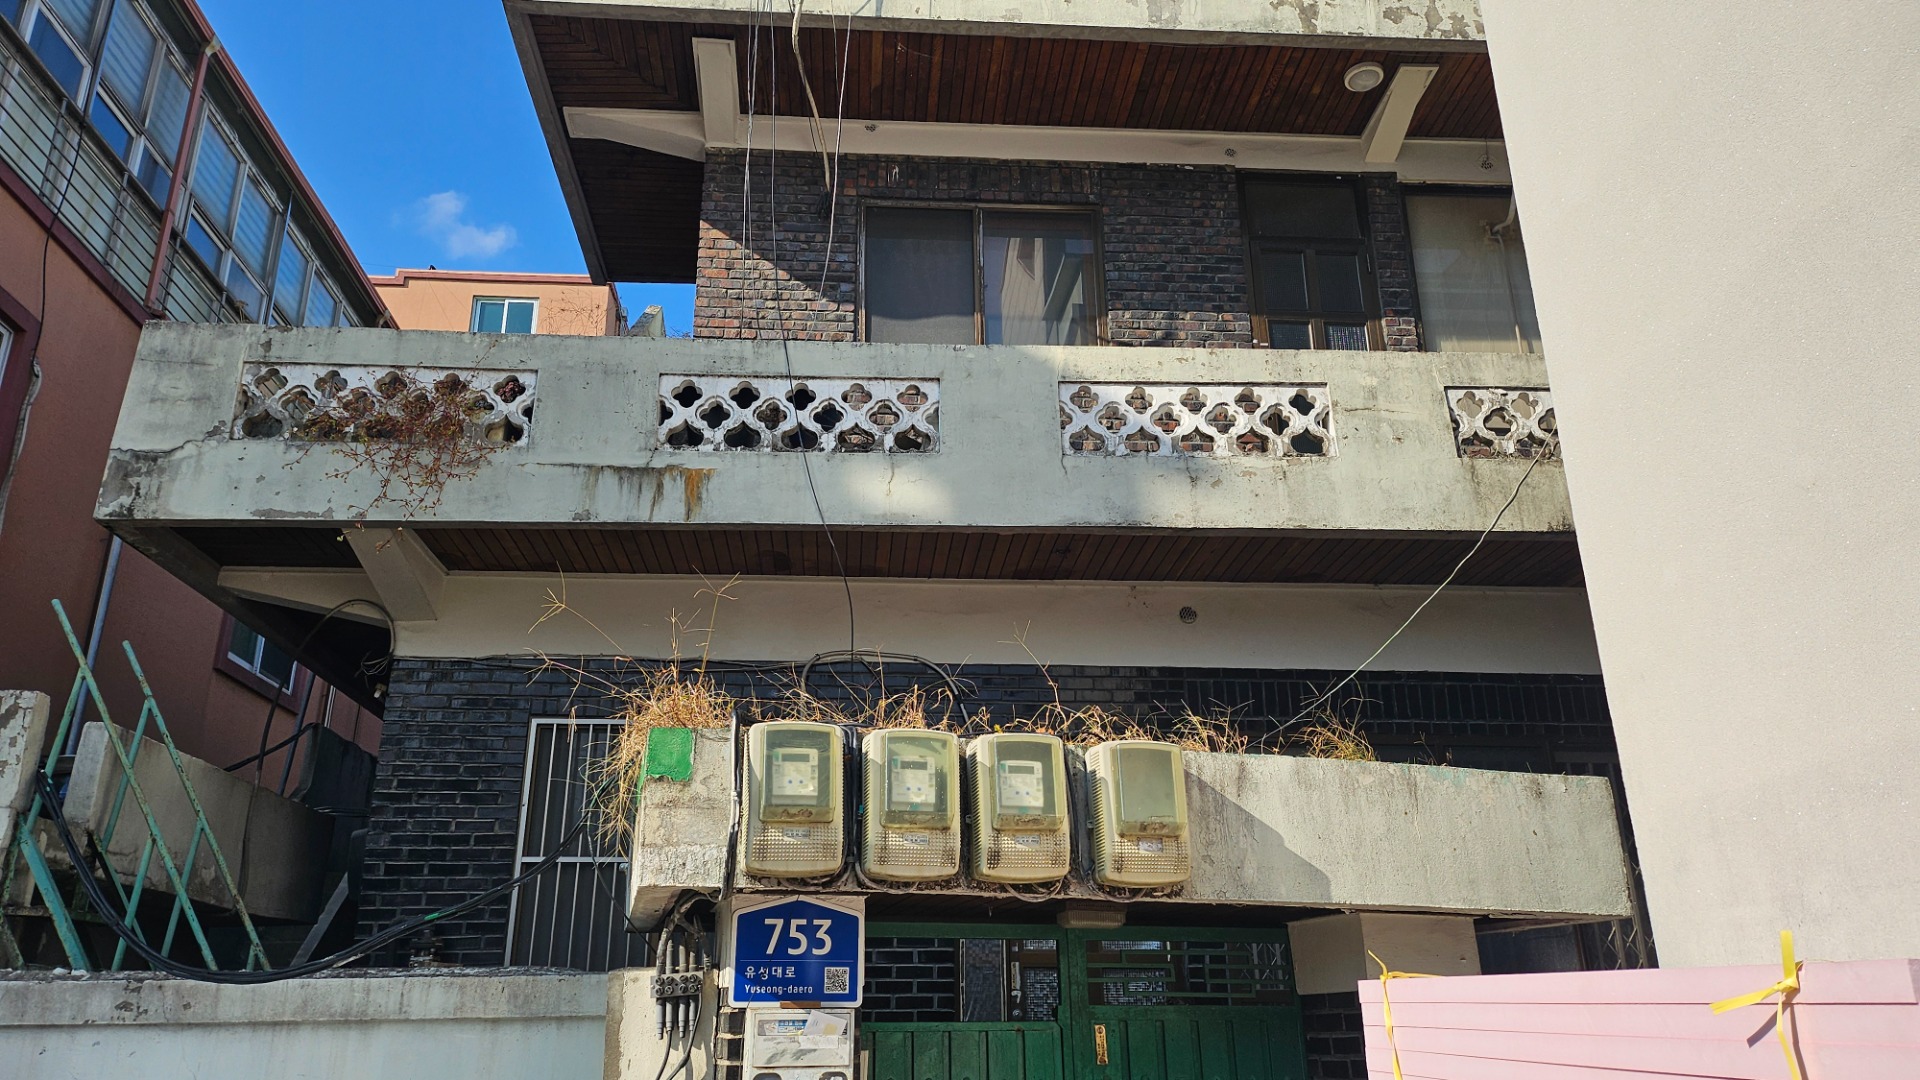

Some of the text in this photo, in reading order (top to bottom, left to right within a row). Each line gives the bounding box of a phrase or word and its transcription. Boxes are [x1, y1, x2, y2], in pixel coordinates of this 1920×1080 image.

[764, 918, 832, 955] 753
[745, 966, 796, 980] 유성대로
[744, 984, 813, 995] Yuseong-daero
